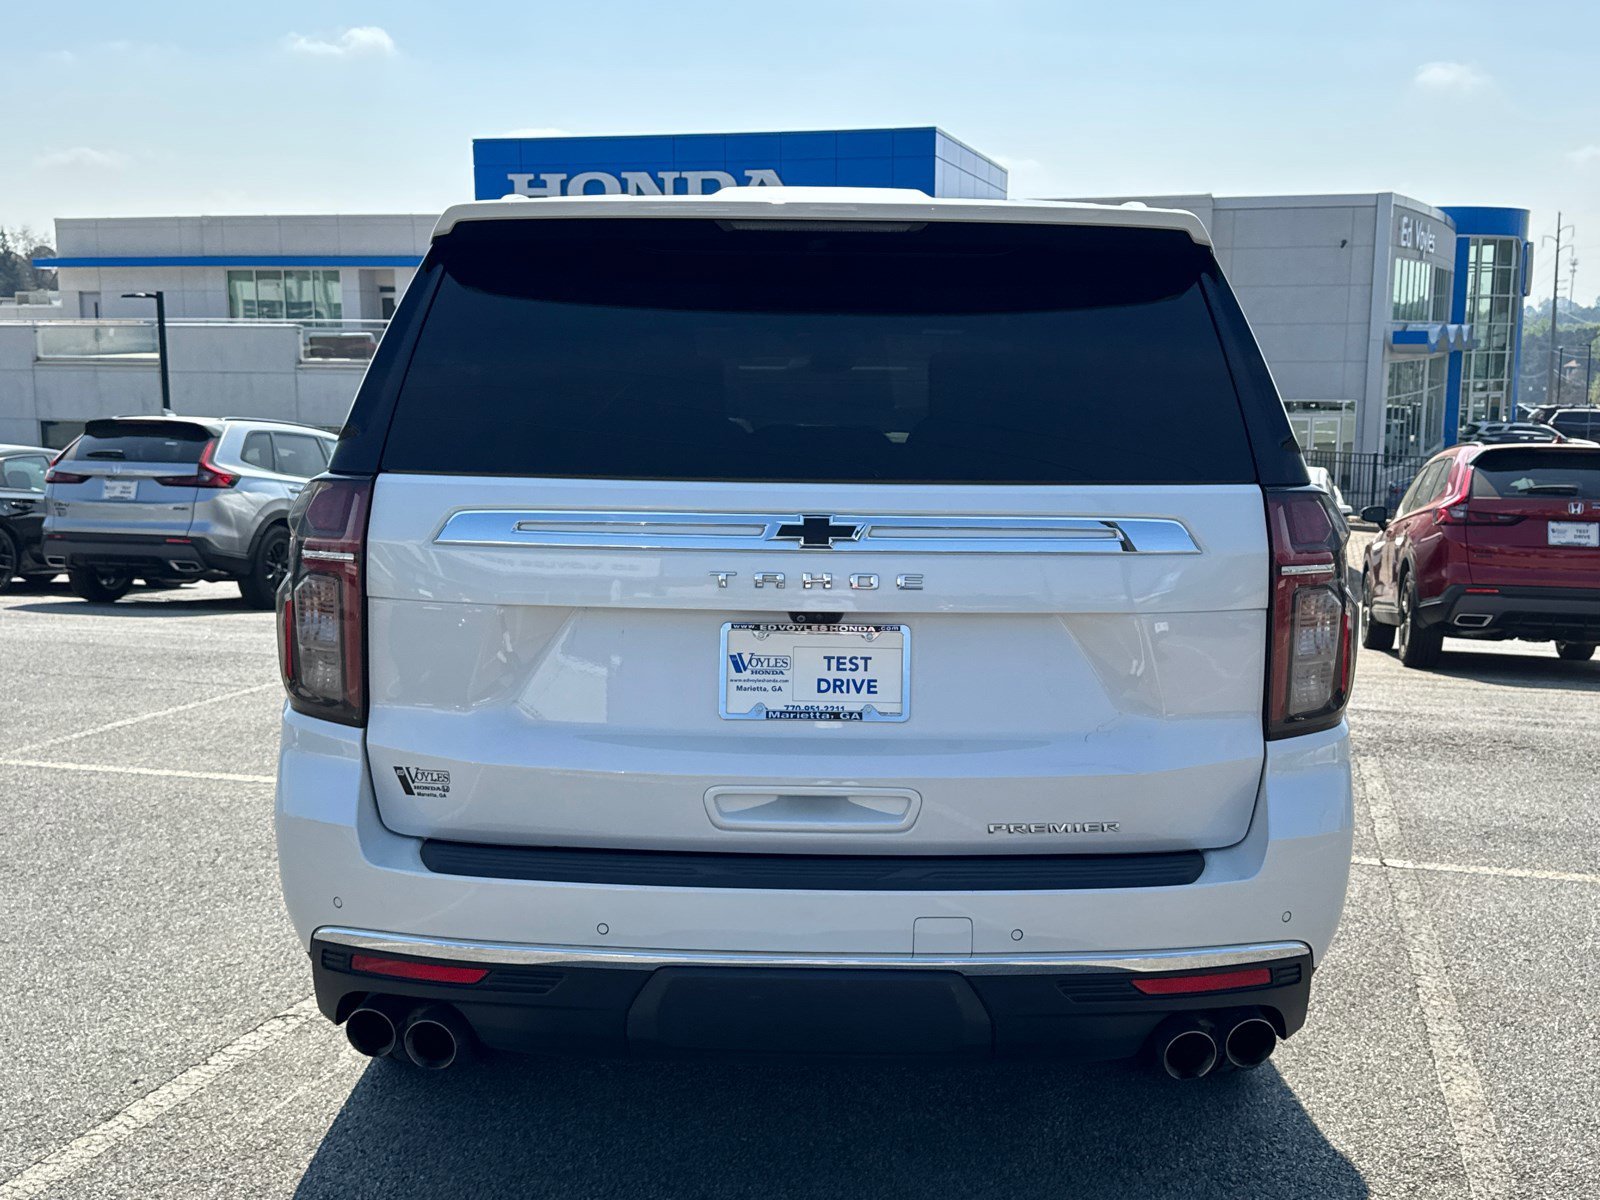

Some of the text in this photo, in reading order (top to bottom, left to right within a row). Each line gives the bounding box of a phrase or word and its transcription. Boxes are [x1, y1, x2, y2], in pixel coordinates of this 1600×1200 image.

[1399, 216, 1436, 259] Ed Voyles
[709, 571, 924, 591] TAHOE
[736, 652, 789, 672] VOYLES
[823, 656, 872, 672] TEST
[816, 678, 878, 694] DRIVE
[768, 711, 833, 719] Marietta,
[405, 766, 449, 784] VOYLES
[987, 821, 1120, 834] PREMIER
